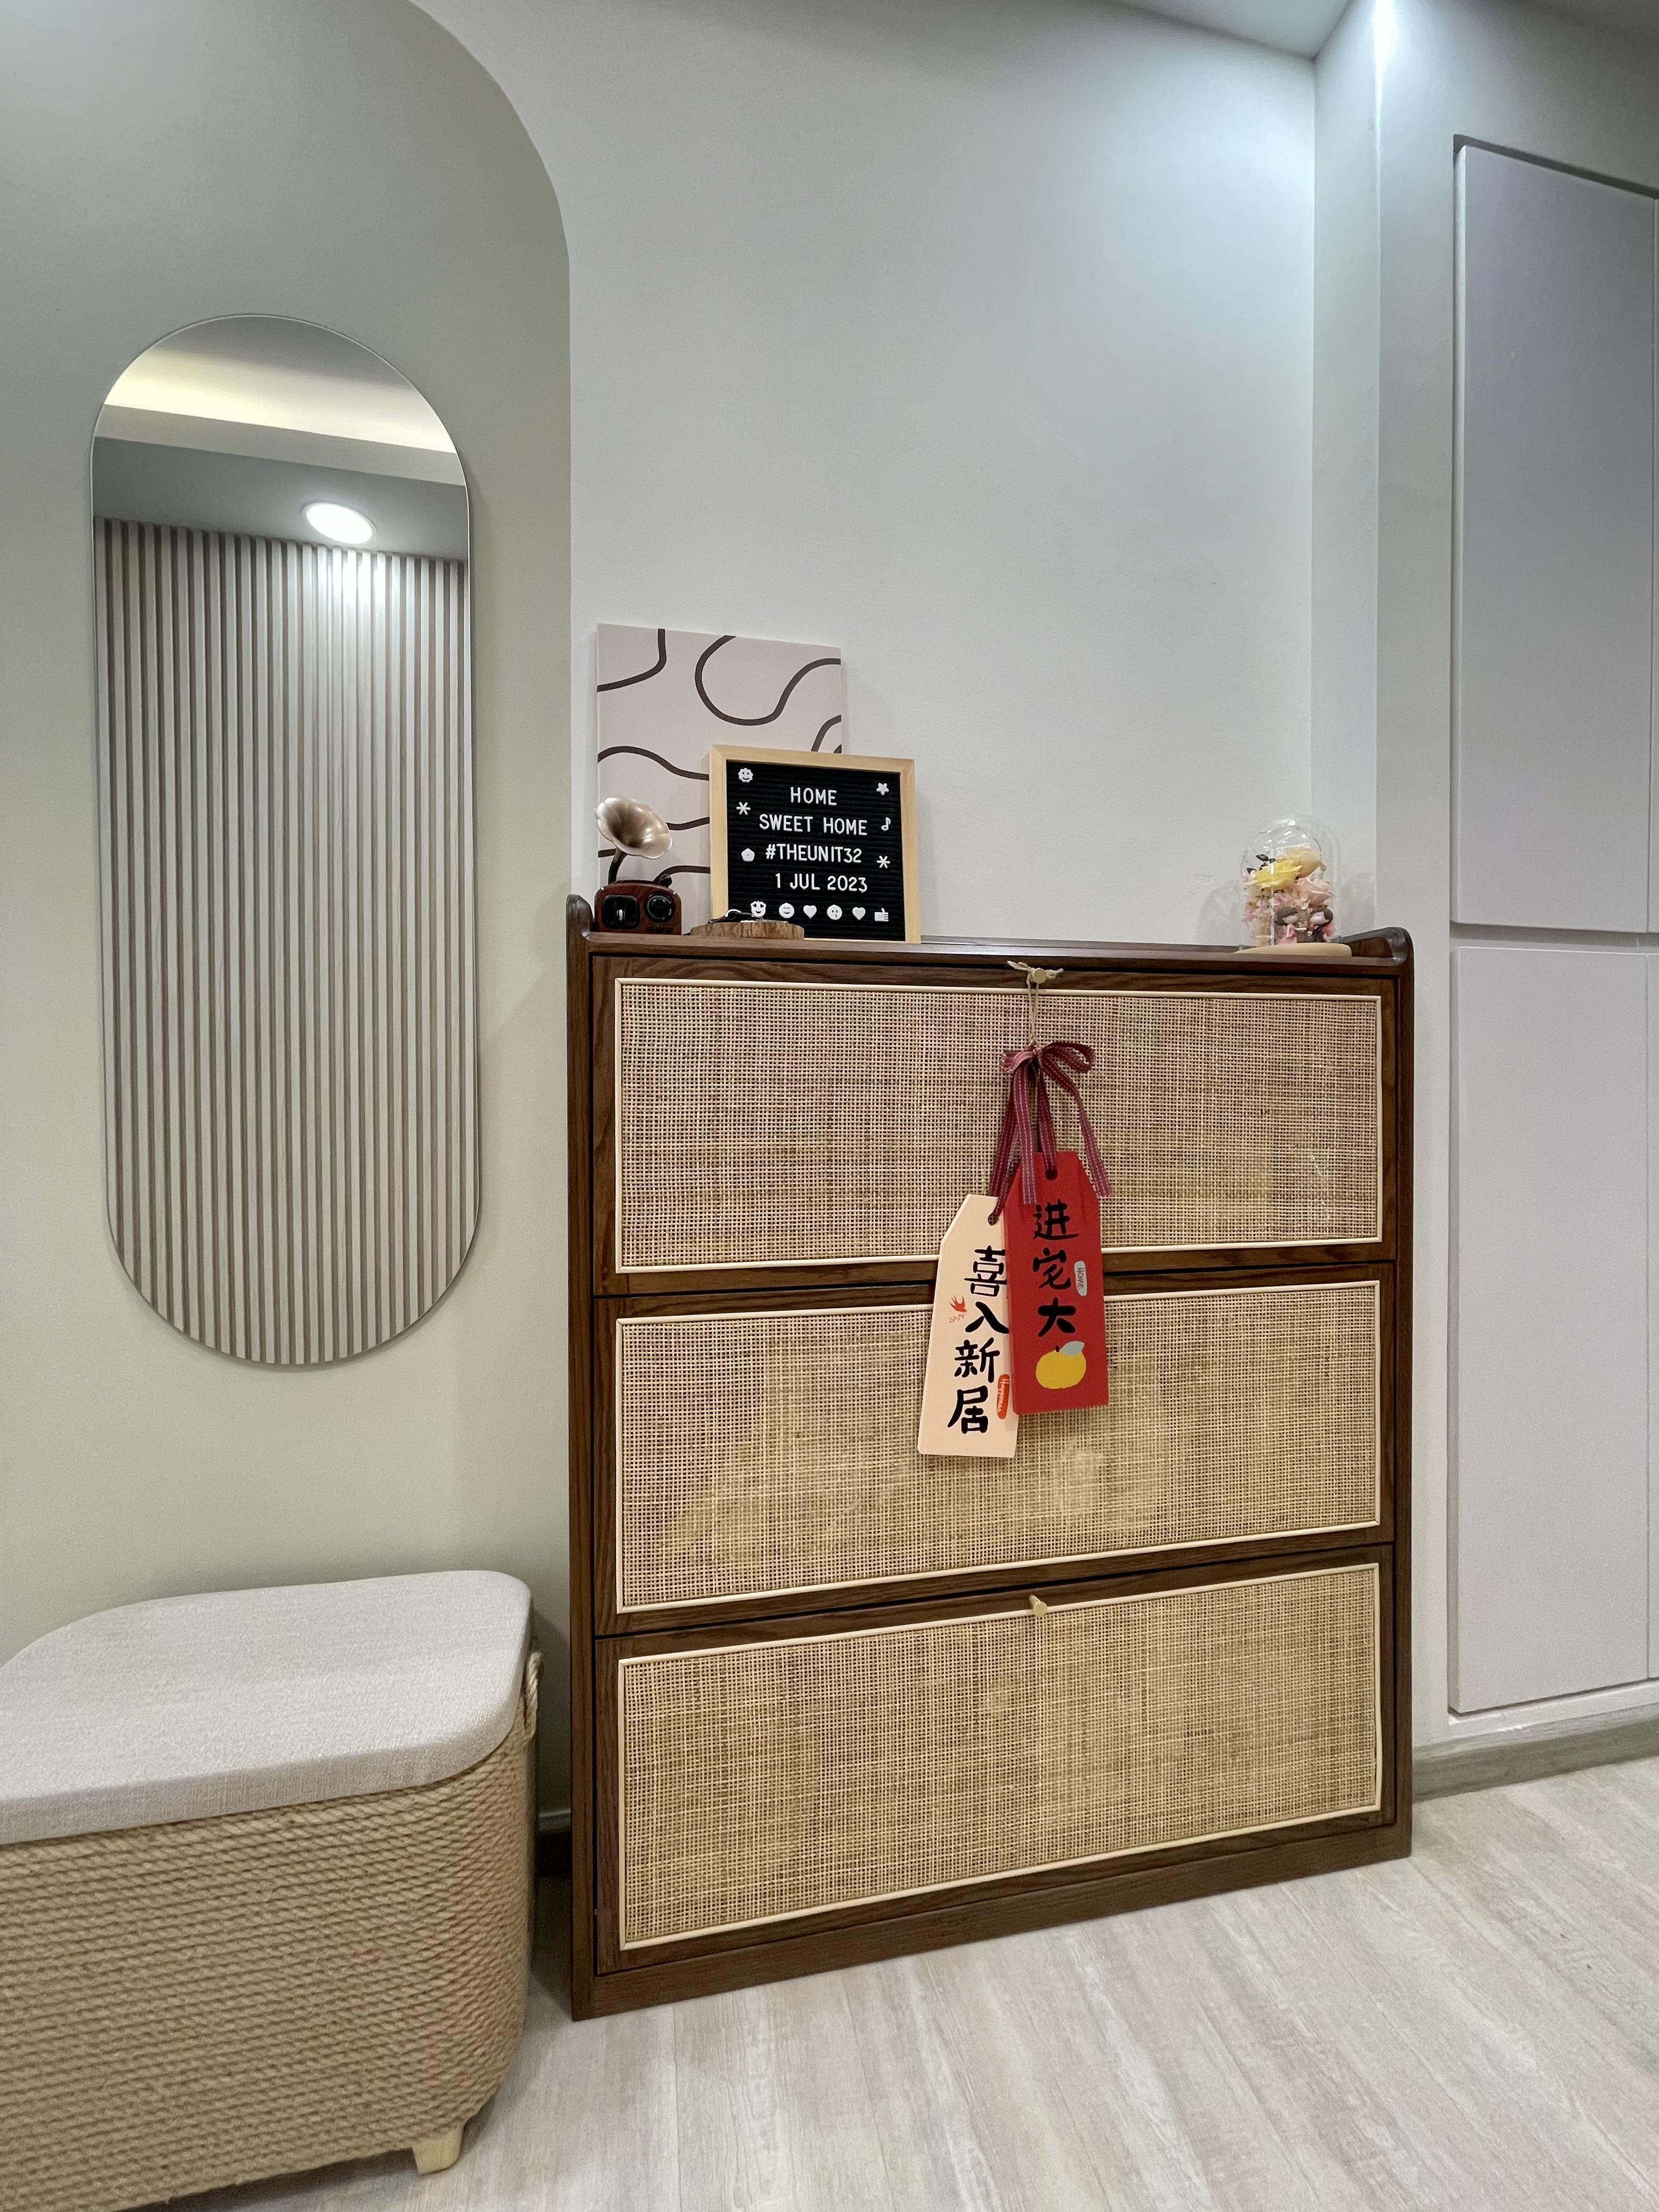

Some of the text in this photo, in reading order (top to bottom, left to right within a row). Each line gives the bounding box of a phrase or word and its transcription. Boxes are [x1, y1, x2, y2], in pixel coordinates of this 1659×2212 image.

[790, 786, 837, 806] HOME
[759, 814, 868, 836] SWEET HOME
[765, 843, 862, 864] #THEUNIT32
[775, 873, 868, 893] 1 JUL 2023
[1032, 1199, 1079, 1338] 进宅大
[1076, 1267, 1085, 1291] HOME
[947, 1245, 1009, 1434] 喜入新居
